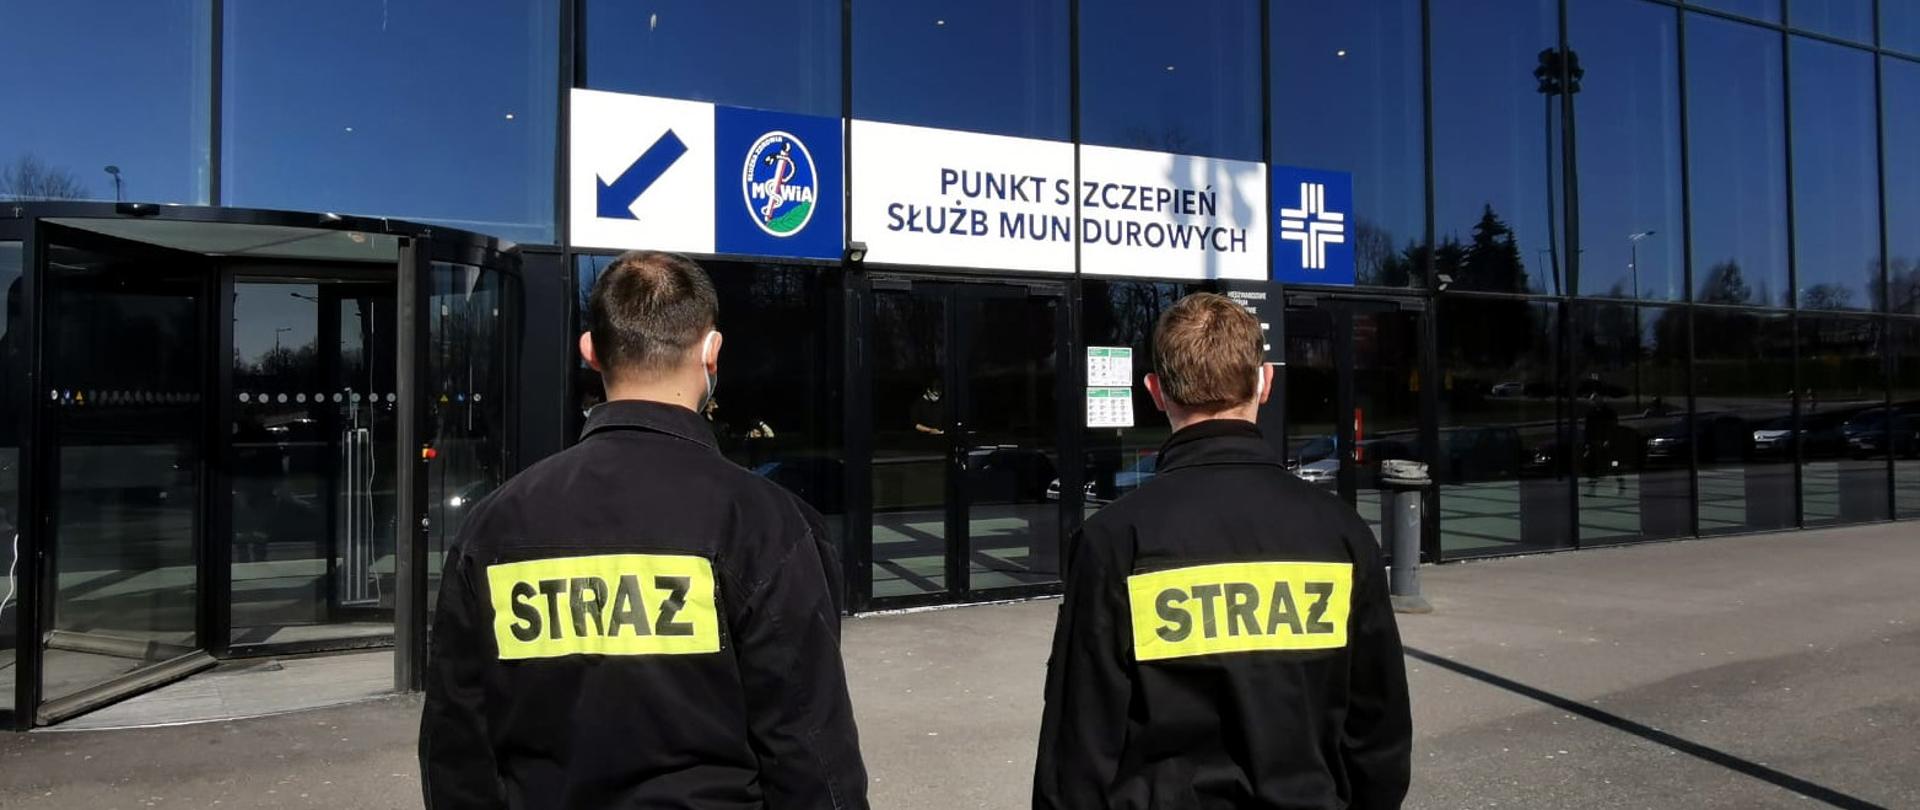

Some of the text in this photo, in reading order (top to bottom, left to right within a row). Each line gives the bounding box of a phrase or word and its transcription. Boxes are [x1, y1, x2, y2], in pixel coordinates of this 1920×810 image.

[941, 168, 1216, 217] PUNKT SZCZEPIEŃ
[887, 199, 1247, 253] SŁUŻB MUNDUROWYCH
